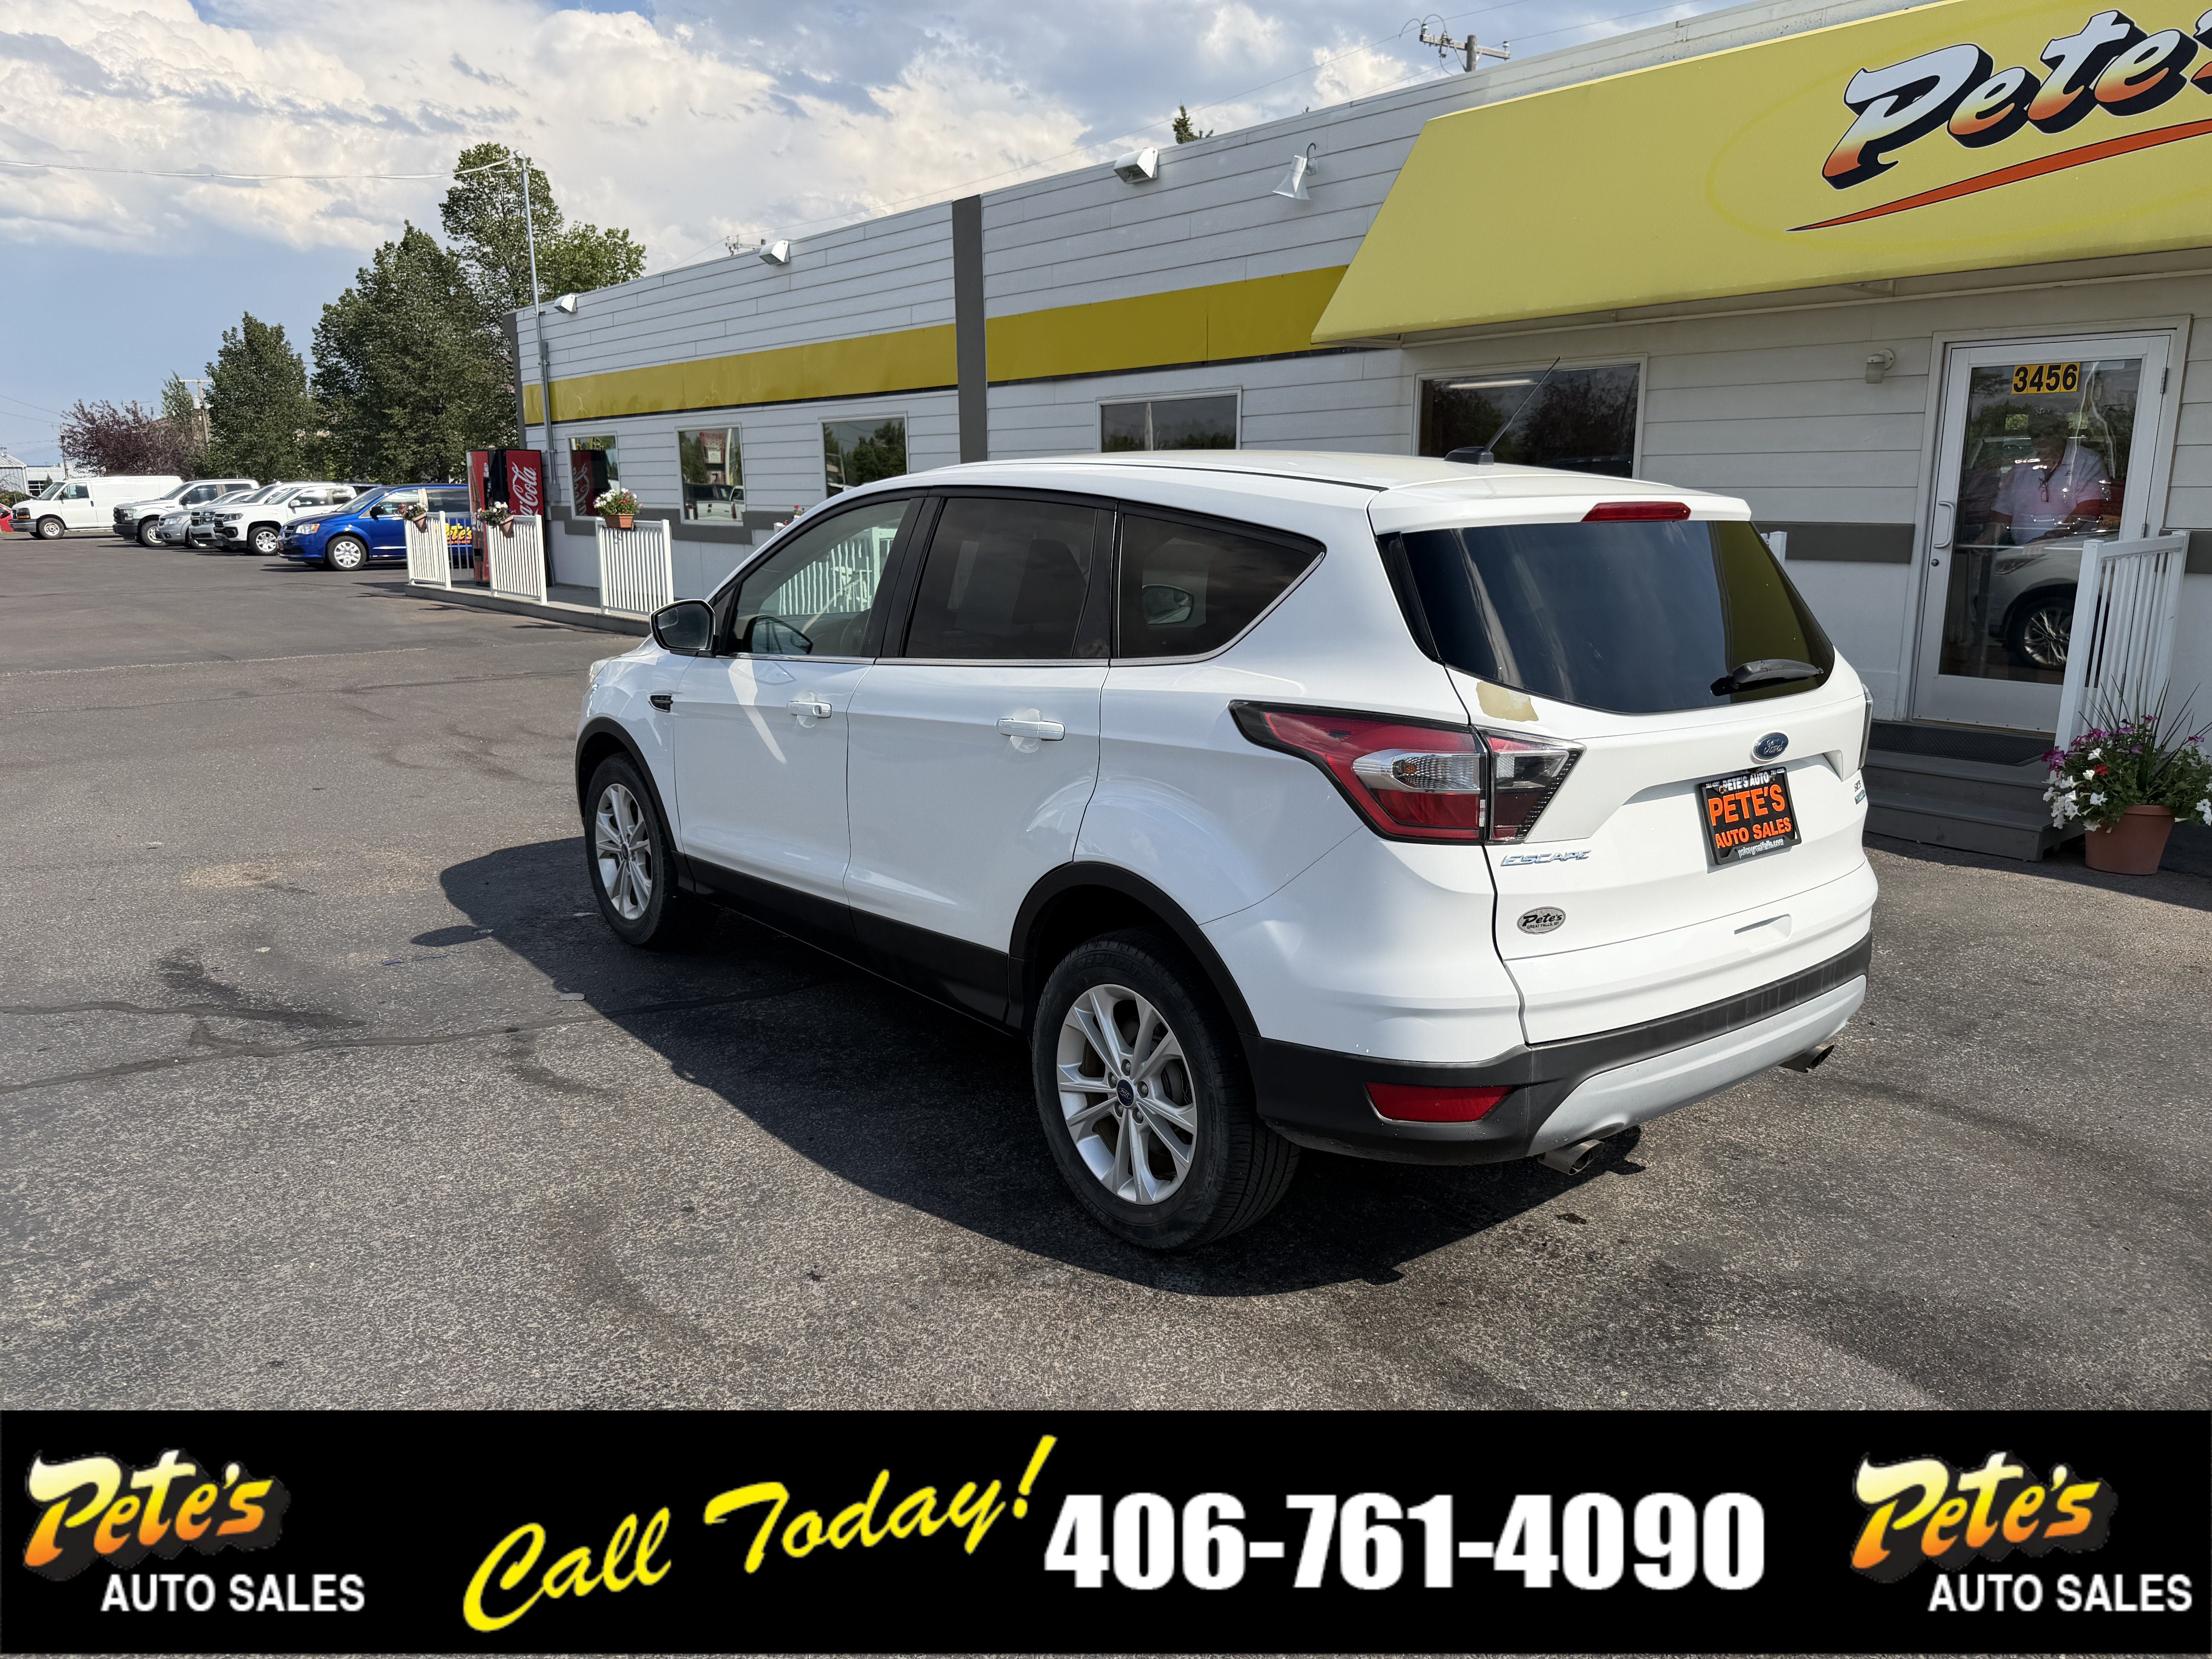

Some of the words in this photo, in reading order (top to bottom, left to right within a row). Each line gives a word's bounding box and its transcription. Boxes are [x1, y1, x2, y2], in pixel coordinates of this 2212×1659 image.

[2013, 364, 2078, 393] 3456
[1763, 738, 1783, 755] Ford
[1723, 776, 1749, 791] PETE'S
[1750, 771, 1770, 786] AUTO
[1708, 784, 1785, 826] PETE'S
[1715, 827, 1749, 849] AUTO
[1752, 817, 1791, 840] SALES
[1501, 850, 1592, 867] ESCAPE
[1522, 913, 1563, 927] Pete's
